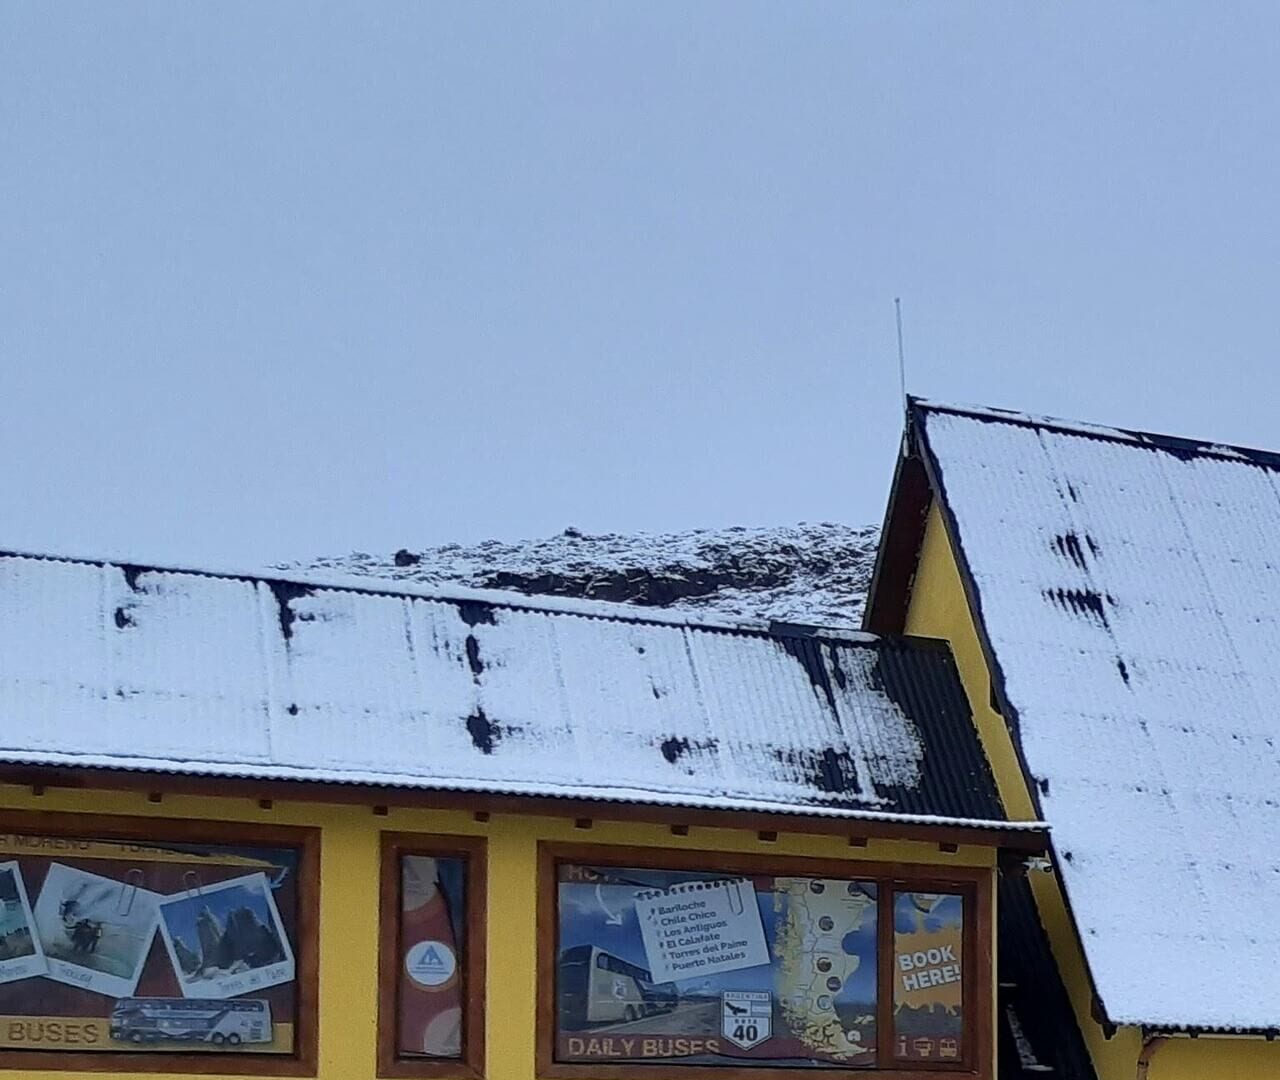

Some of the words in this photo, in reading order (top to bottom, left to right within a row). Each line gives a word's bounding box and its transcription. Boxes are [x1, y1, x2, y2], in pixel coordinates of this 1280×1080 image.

[658, 900, 706, 915] Bariloche
[660, 916, 687, 927] Chile
[688, 910, 717, 922] Chico
[663, 927, 682, 938] Los
[684, 920, 728, 933] Antiguos
[666, 940, 676, 949] El
[678, 933, 721, 947] Calafate
[669, 948, 701, 960] Torres
[702, 943, 719, 954] del
[721, 939, 748, 951] Paine
[672, 958, 706, 971] Puerto
[707, 952, 747, 965] Natales
[899, 944, 957, 971] BOOK
[902, 965, 961, 992] HERE!
[8, 1022, 98, 1043] BUSES
[733, 1025, 758, 1042] 40
[568, 1038, 634, 1056] DAILY
[643, 1039, 720, 1056] BUSES
